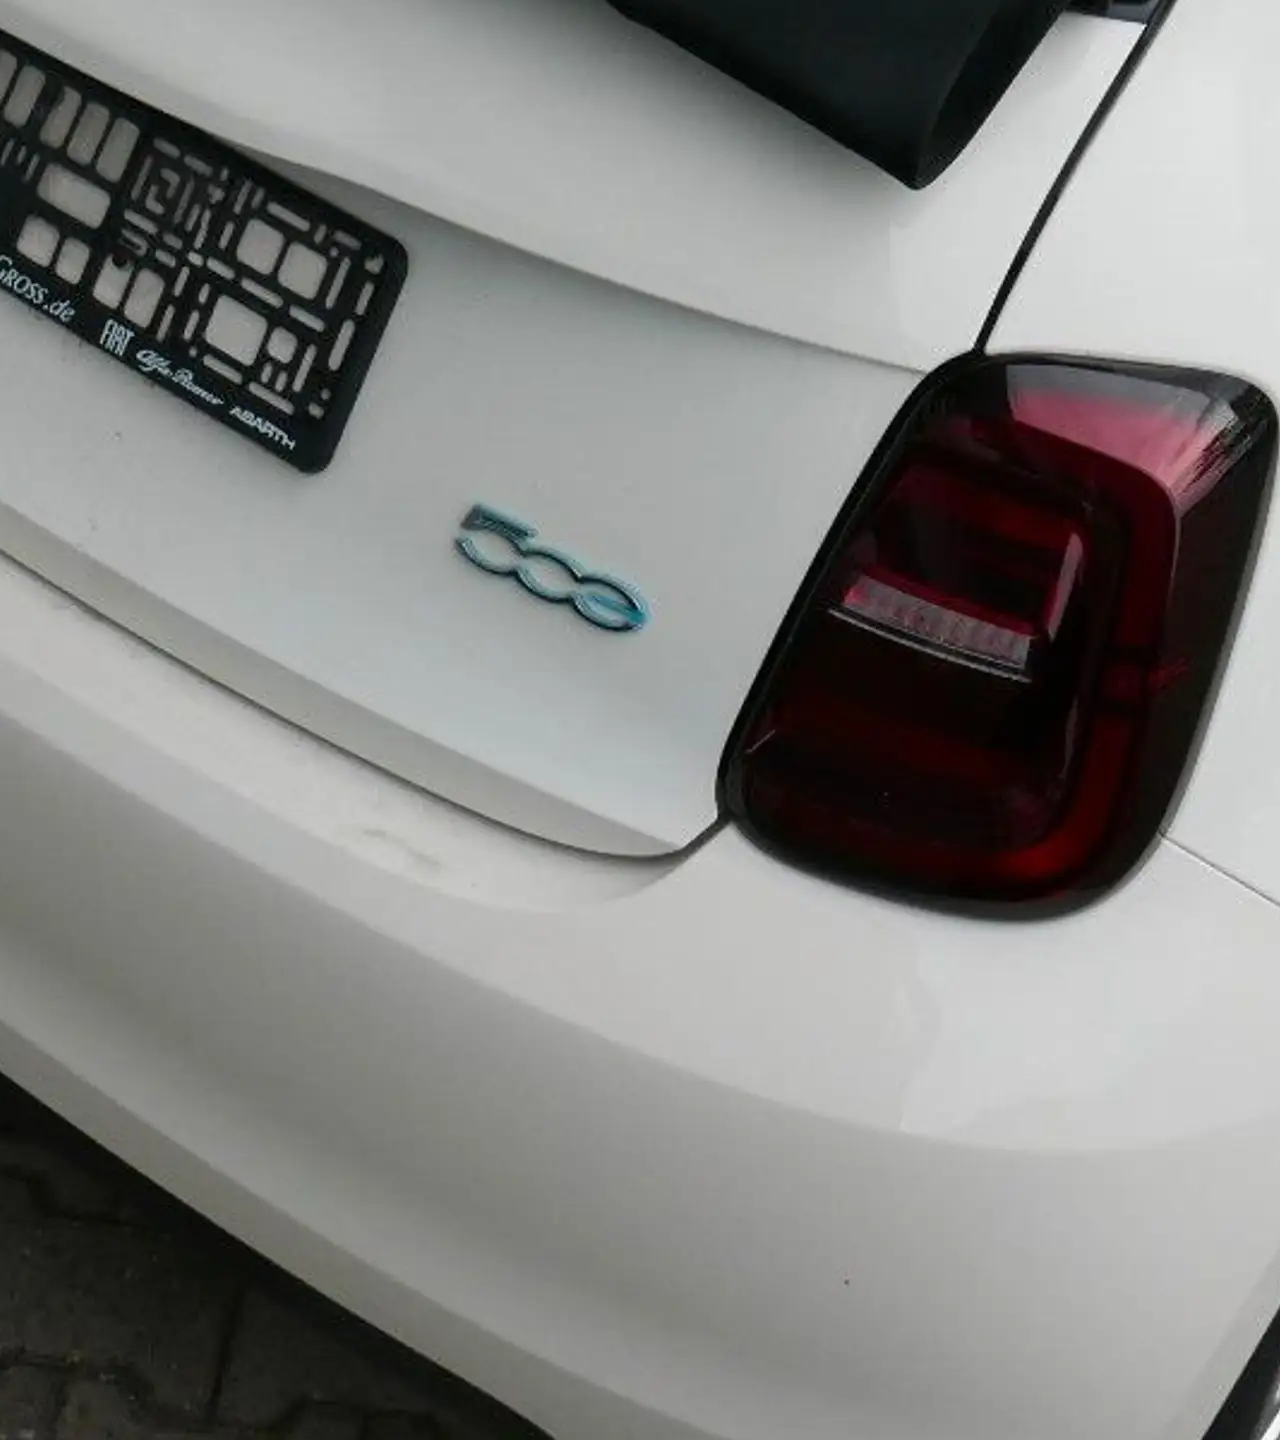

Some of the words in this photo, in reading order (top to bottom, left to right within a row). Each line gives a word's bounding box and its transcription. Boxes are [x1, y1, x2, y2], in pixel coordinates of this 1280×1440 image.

[99, 318, 136, 357] FIAT
[229, 405, 297, 452] ABARTH
[455, 503, 650, 633] 500
